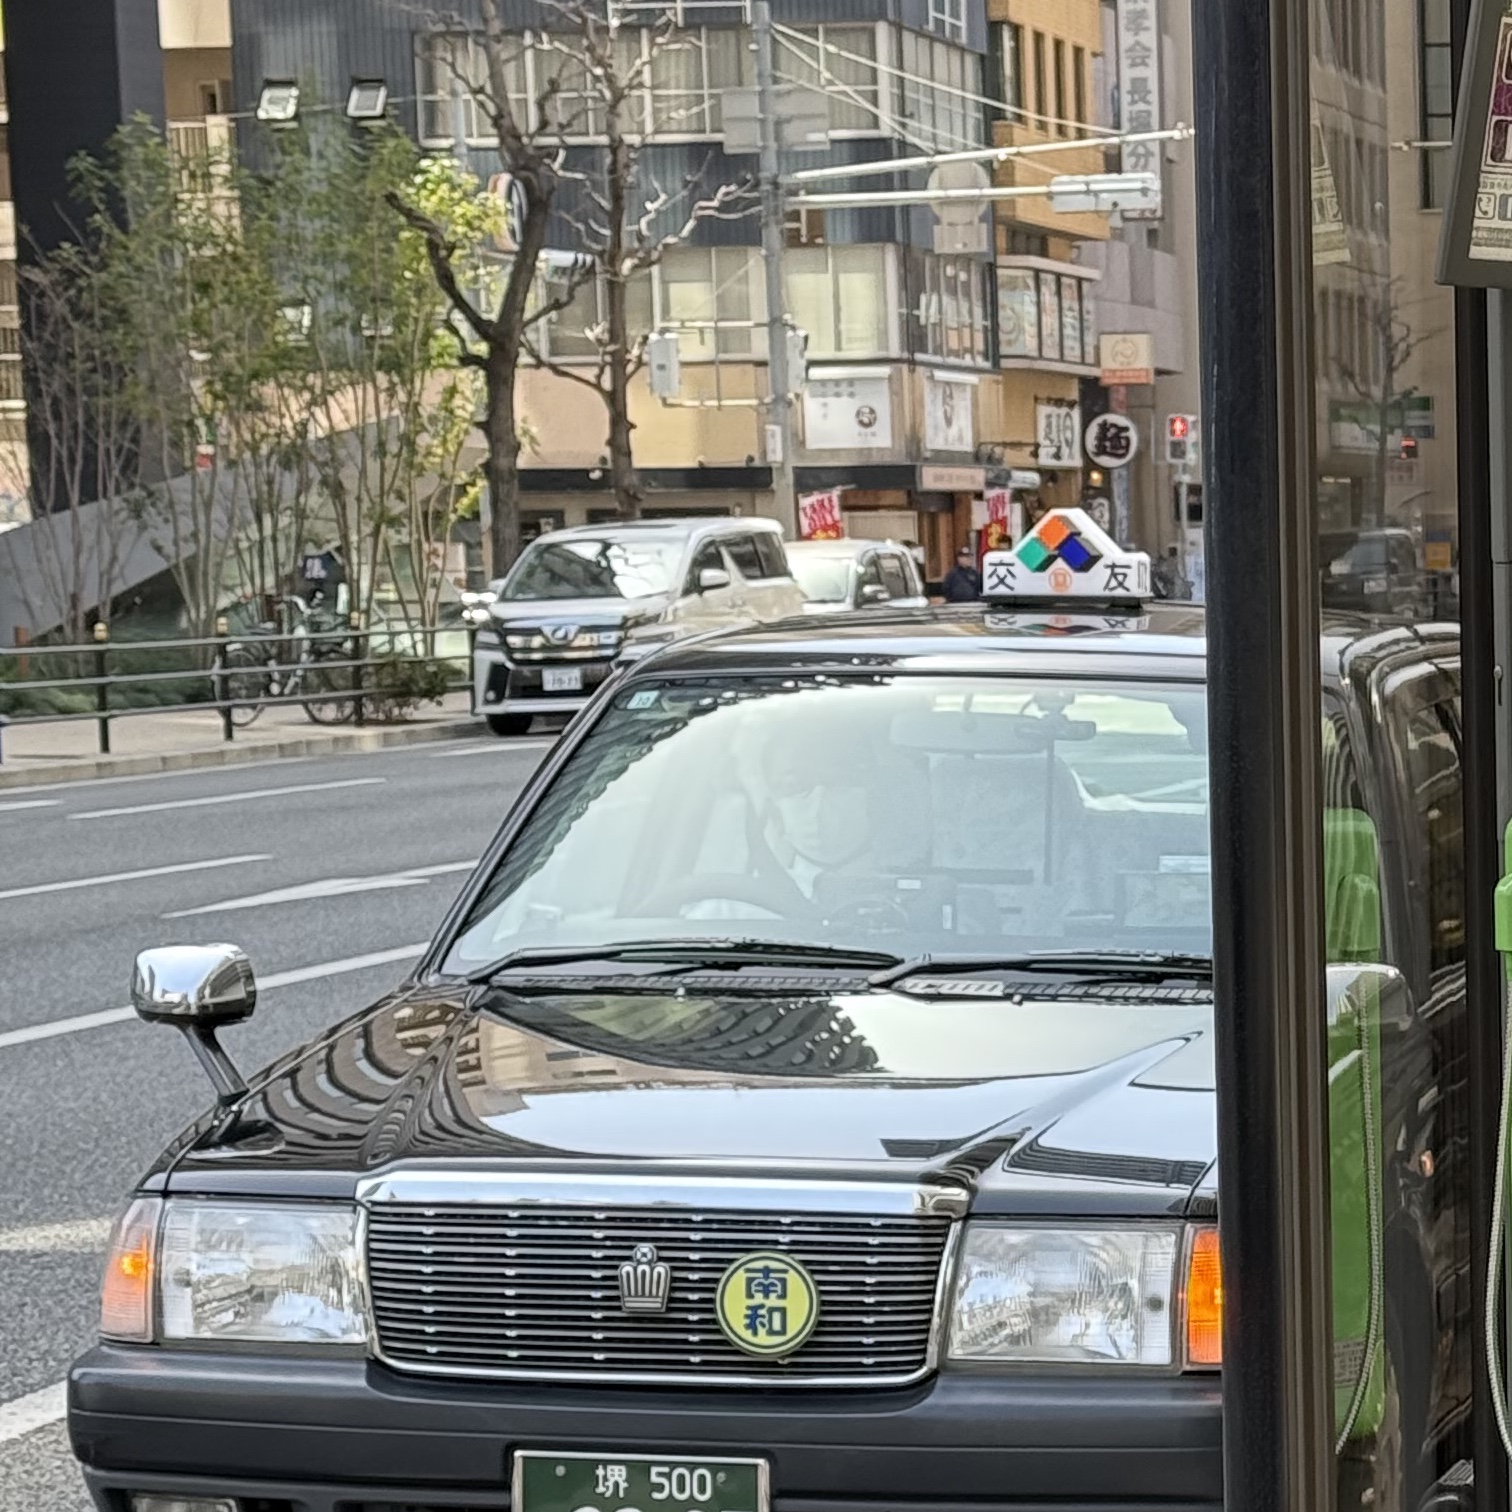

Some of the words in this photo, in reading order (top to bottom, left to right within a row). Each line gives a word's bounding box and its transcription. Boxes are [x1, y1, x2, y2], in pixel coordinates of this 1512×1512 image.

[987, 560, 1017, 592] 交
[1102, 561, 1133, 593] 友
[743, 1265, 790, 1337] 南和
[594, 1464, 629, 1499] 堺
[650, 1466, 713, 1502] 500
